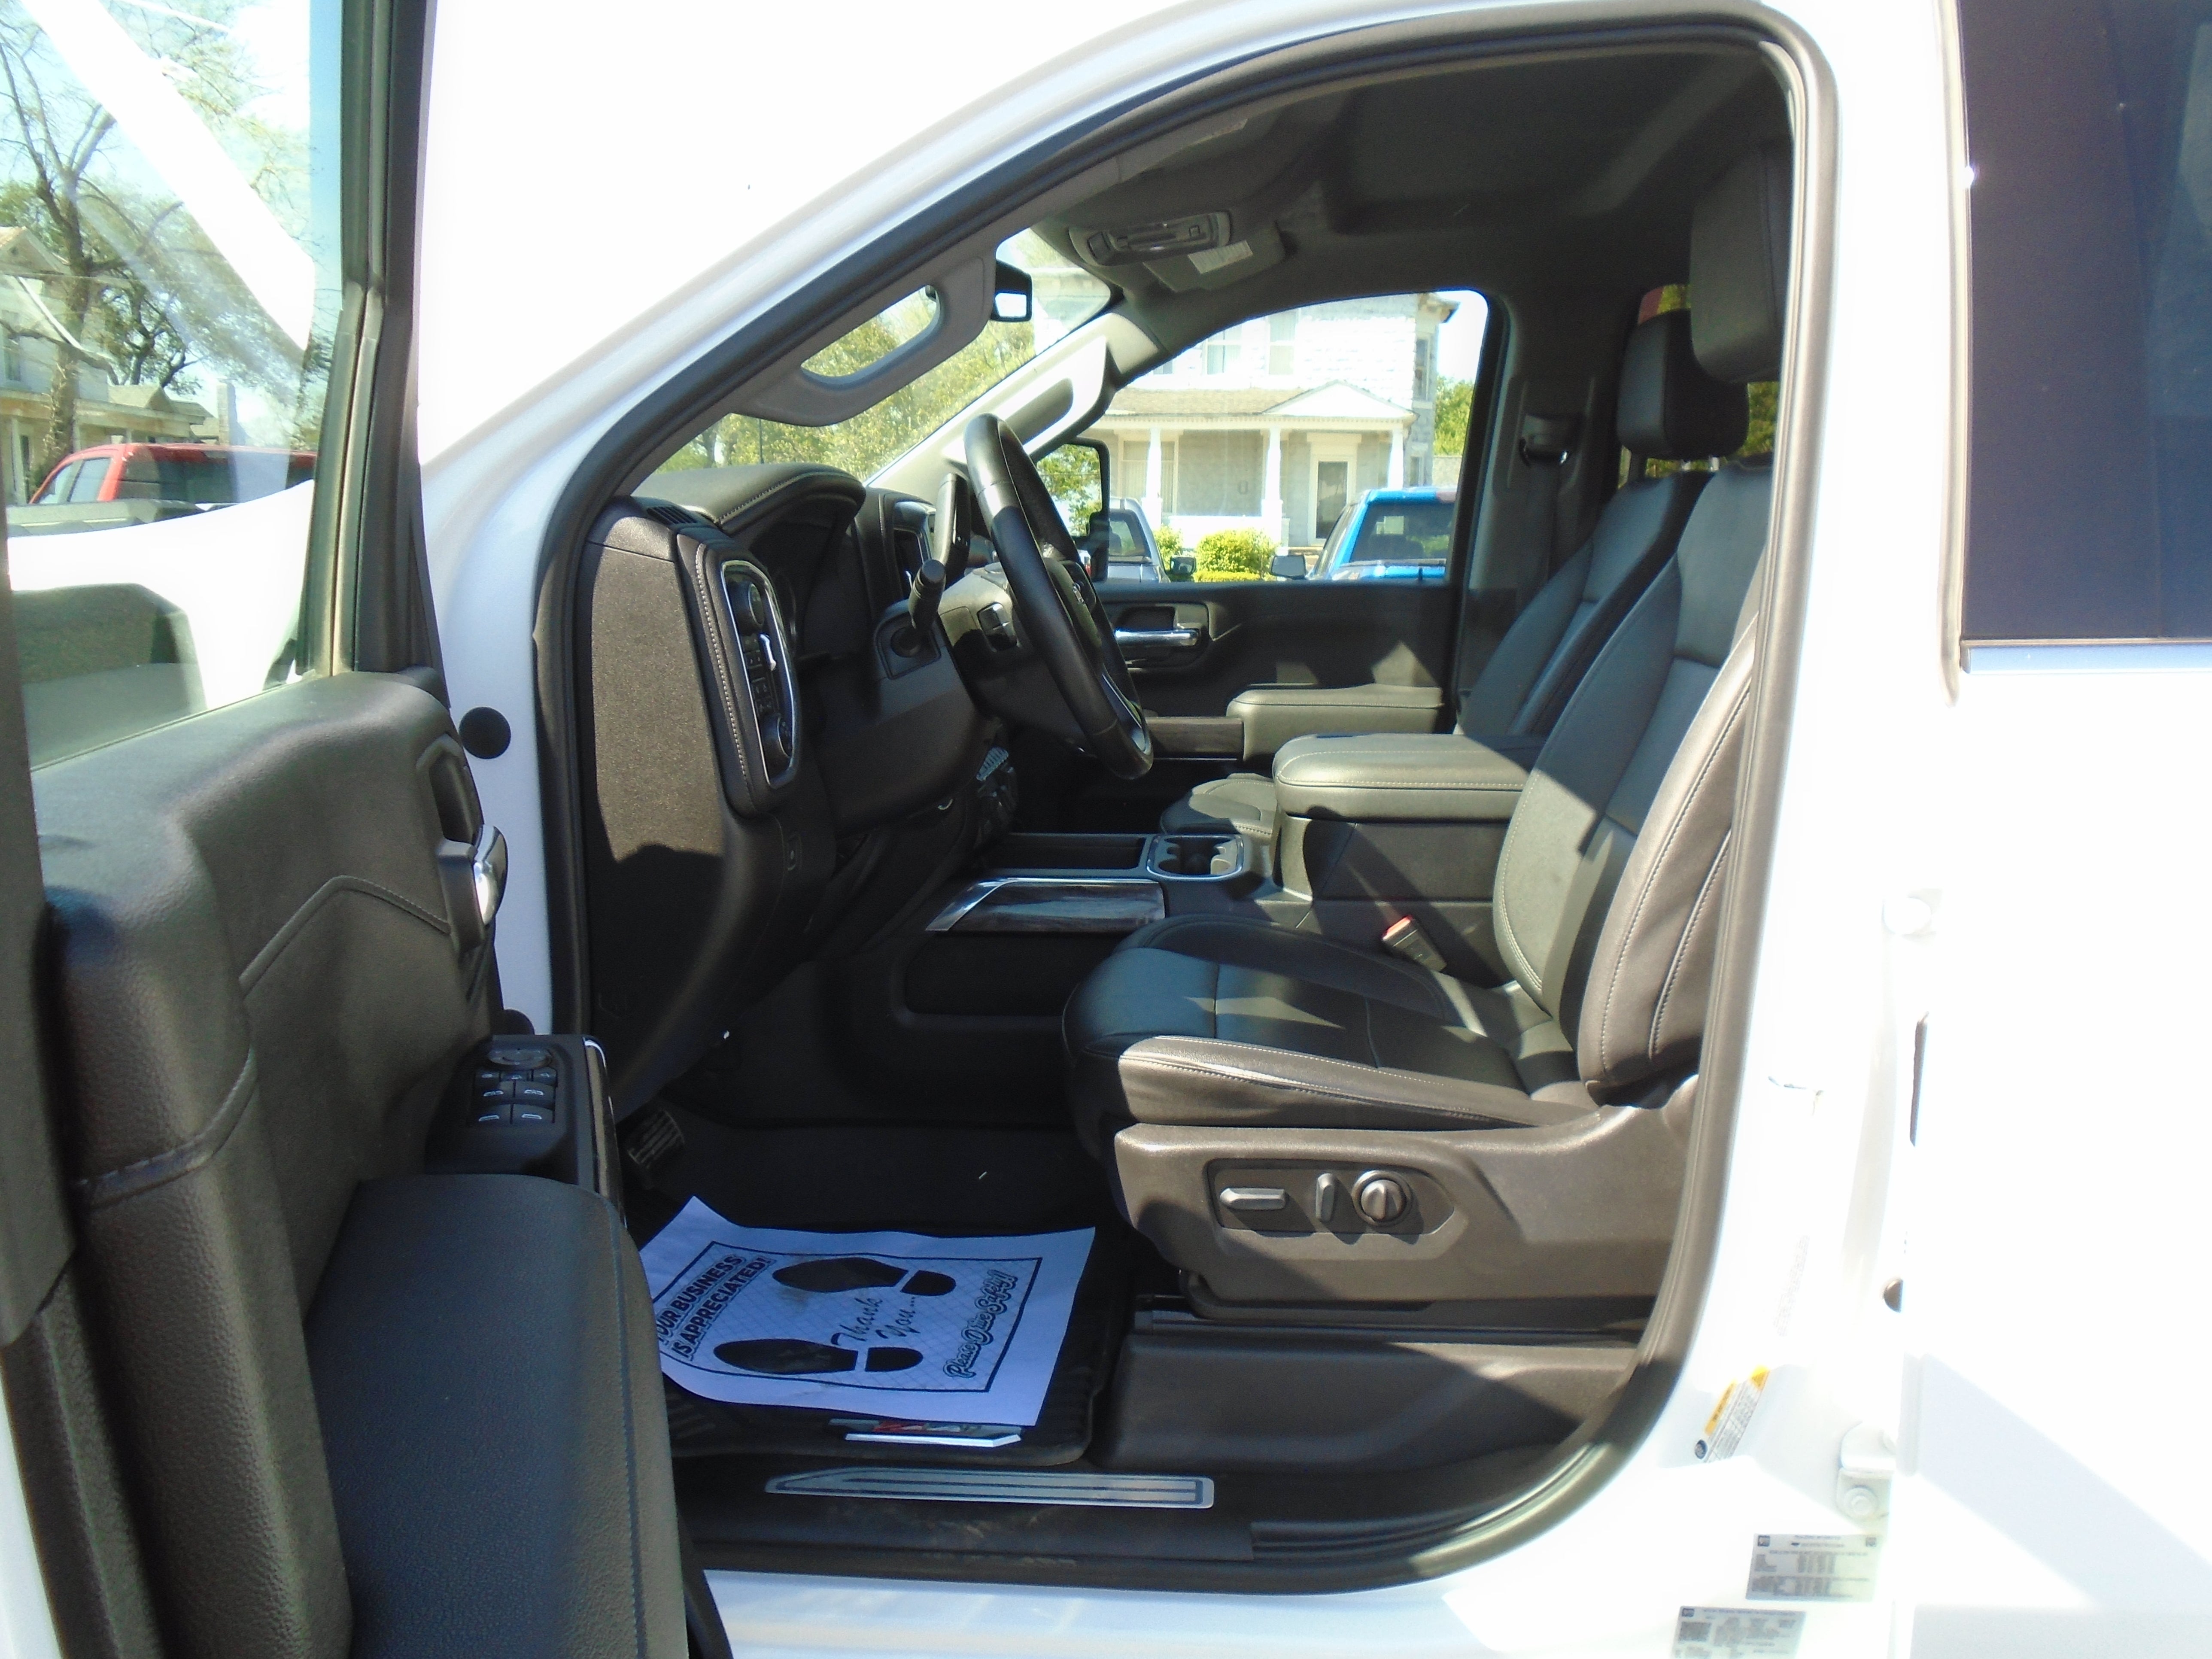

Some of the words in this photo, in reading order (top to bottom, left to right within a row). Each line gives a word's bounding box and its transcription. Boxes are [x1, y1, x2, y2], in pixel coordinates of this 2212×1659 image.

[670, 1256, 743, 1310] BUSINESS
[680, 1257, 772, 1345] APPRECIATED!
[830, 1297, 883, 1346] Thank
[944, 1344, 978, 1378] Please
[963, 1312, 993, 1344] Drive
[671, 1342, 693, 1358] IS
